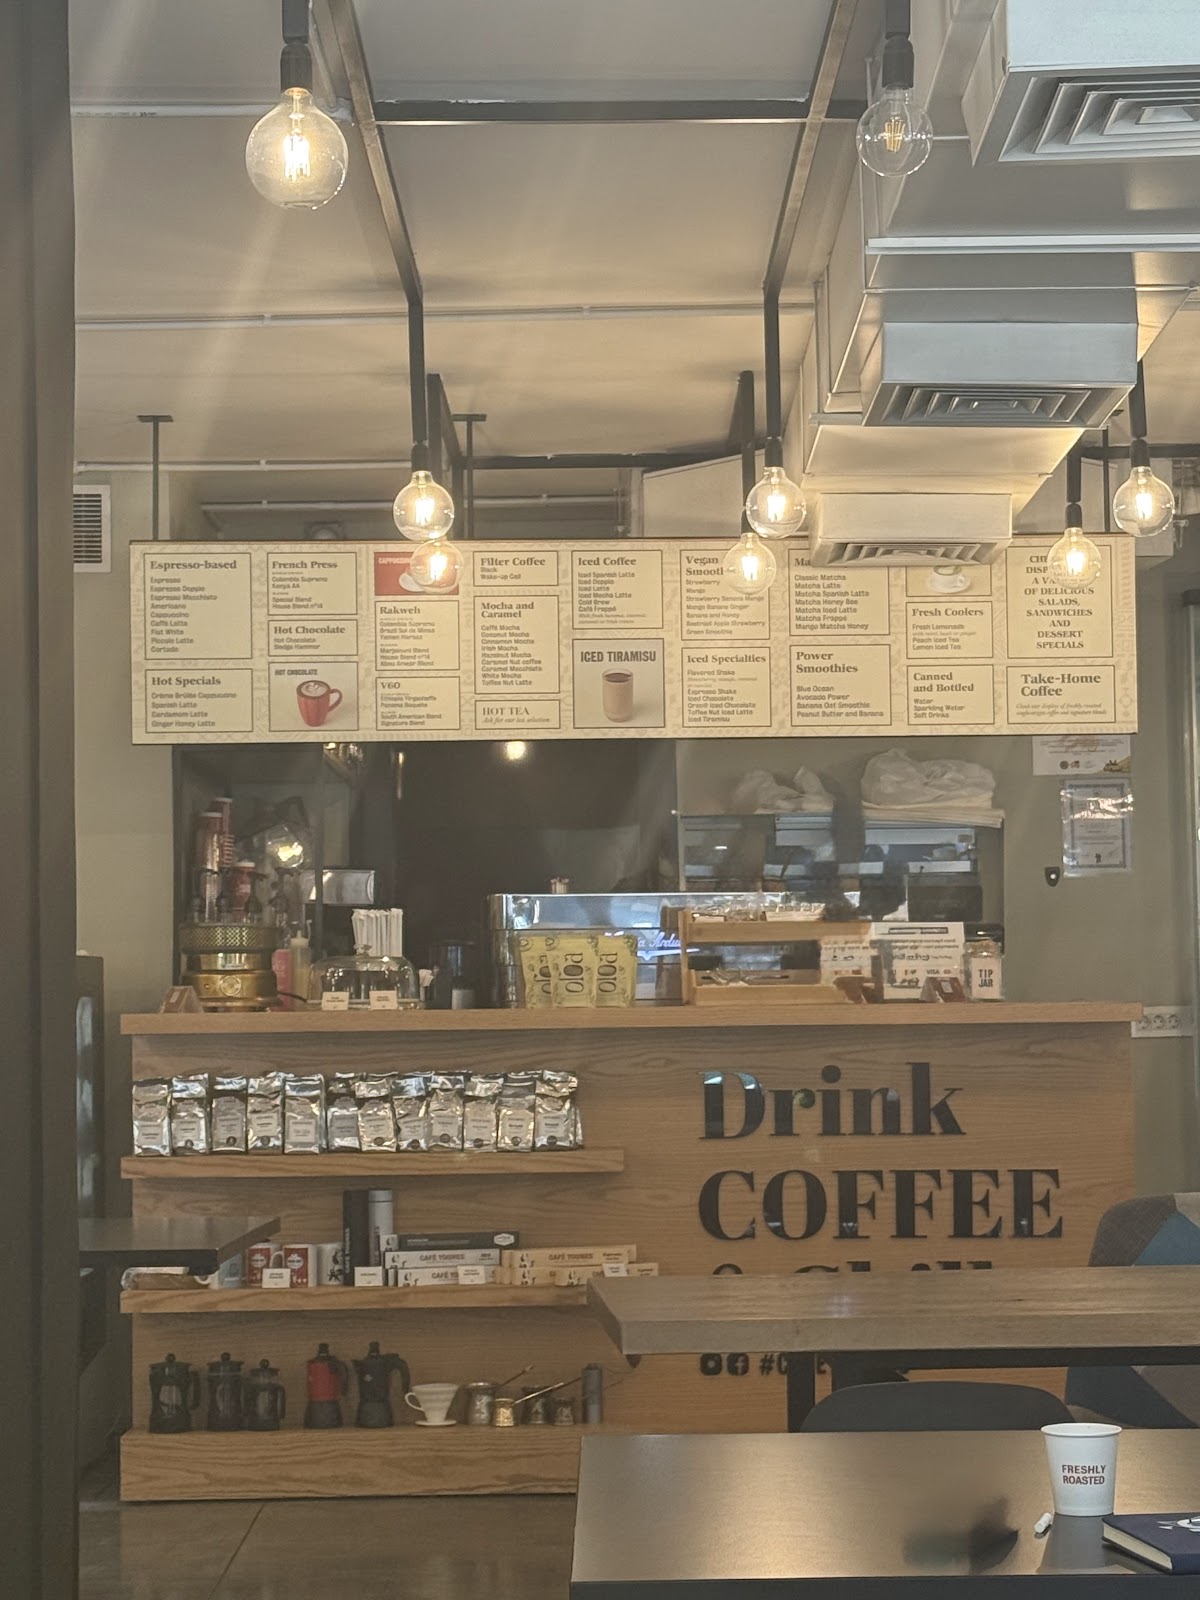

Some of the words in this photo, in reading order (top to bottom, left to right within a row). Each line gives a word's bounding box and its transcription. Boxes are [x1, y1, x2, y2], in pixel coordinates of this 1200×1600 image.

[272, 561, 307, 569] French
[311, 561, 337, 569] Press
[481, 558, 510, 566] Filter
[513, 558, 545, 566] Coffee
[578, 558, 599, 566] Iced
[604, 558, 636, 566] Coffee
[686, 556, 718, 565] Vegan
[151, 561, 237, 571] Espresso-based
[481, 602, 512, 610] Mocha
[516, 602, 534, 610] and
[1039, 598, 1080, 606] SALADS,
[912, 608, 941, 616] Fresh
[945, 608, 983, 616] Coolers
[274, 626, 292, 634] Hot
[296, 626, 345, 634] Chocolate
[581, 651, 603, 662] ICED
[607, 651, 656, 662] TIRAMISU
[687, 655, 708, 663] Iced
[712, 655, 766, 663] Specialties
[796, 652, 833, 660] Power
[796, 664, 858, 673] Smoothies
[914, 672, 952, 680] Canned
[1021, 674, 1101, 683] Take-Home
[152, 677, 172, 686] Hot
[175, 677, 221, 686] Specials
[914, 684, 932, 692] and
[937, 684, 974, 692] Bottled
[1021, 686, 1062, 696] Coffee
[978, 969, 993, 978] TIP
[978, 979, 993, 988] JAR
[697, 1062, 966, 1139] Drink
[699, 1169, 1063, 1240] COFFEE
[1062, 1465, 1106, 1474] FRESHLY
[1063, 1476, 1104, 1485] ROASTED
